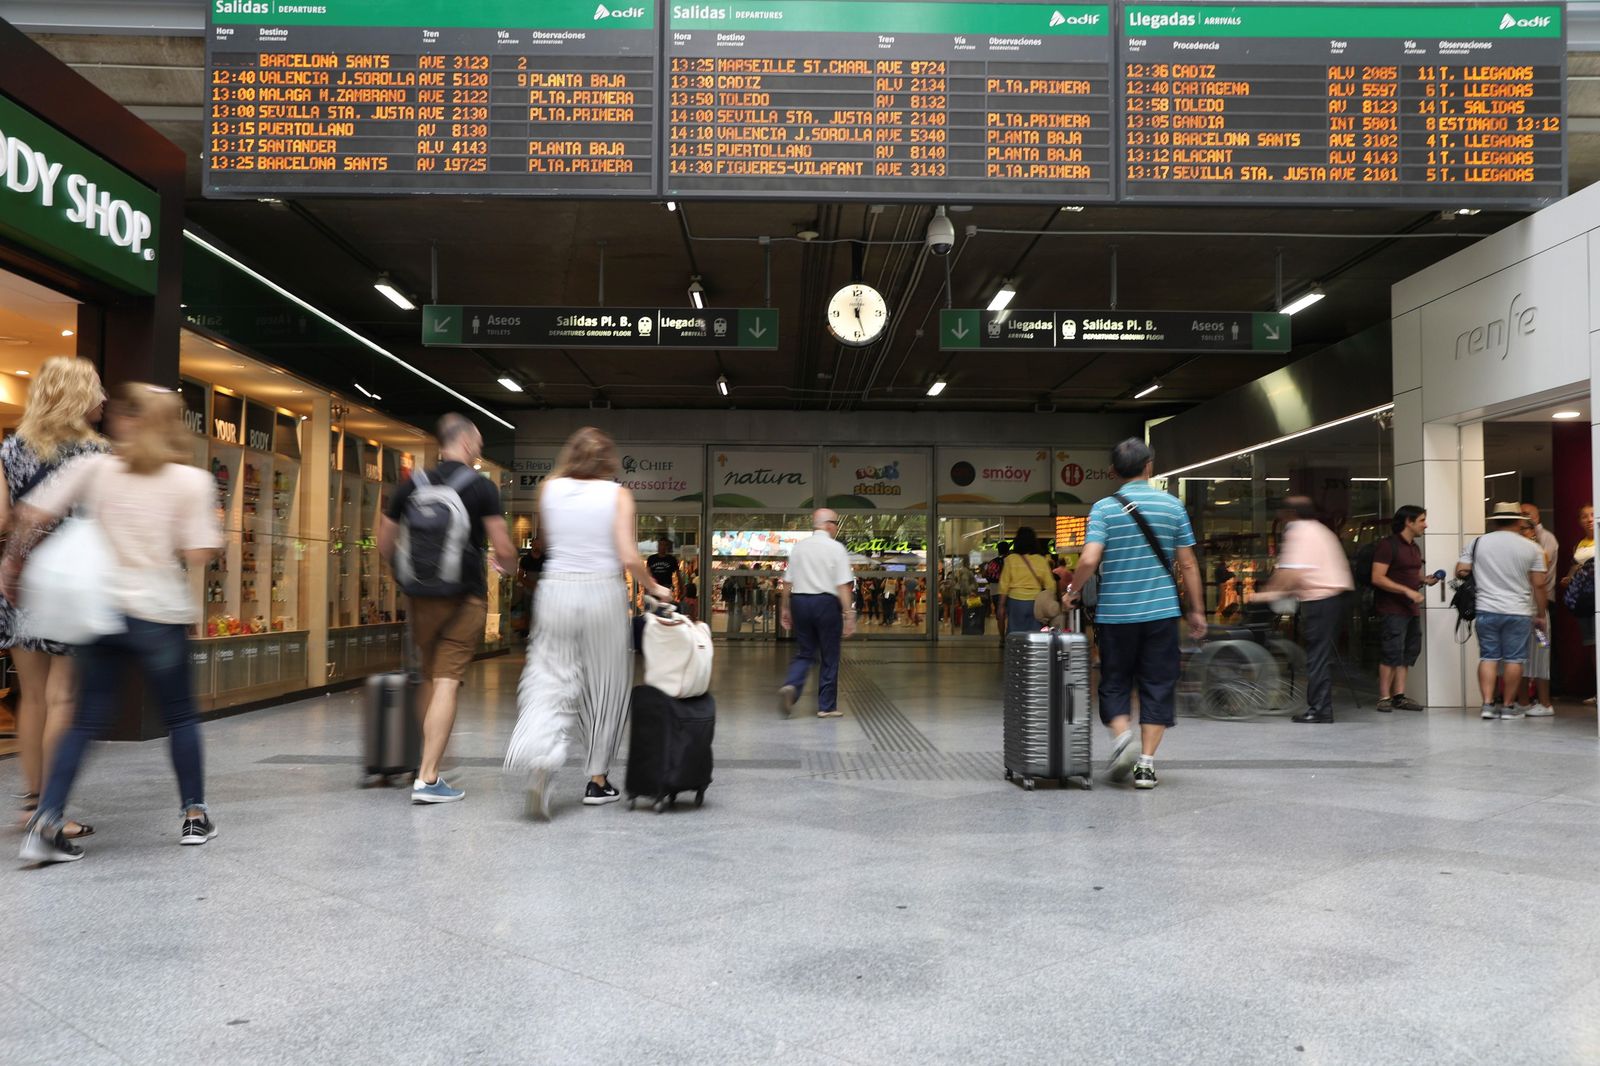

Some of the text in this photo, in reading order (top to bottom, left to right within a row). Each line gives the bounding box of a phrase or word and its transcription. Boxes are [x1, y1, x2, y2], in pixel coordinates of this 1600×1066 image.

[216, 0, 327, 14] Salidas DEPARTURES
[611, 6, 645, 18] adif
[673, 5, 783, 19] Salidas DEPARTURES
[1066, 14, 1101, 25] adif
[1129, 12, 1242, 29] Llegadas ARRIVALS
[1516, 15, 1552, 28] adif
[216, 27, 586, 40] Hora Destino Tren Observaciones
[717, 33, 1042, 46] Destino Observaciones
[1173, 41, 1220, 51] Procedencia
[259, 53, 489, 70] BARCELONA SANTS AVE 3123
[672, 58, 945, 75] 13:25 MARSEILLE ST.CHARL AVE 9724
[212, 70, 626, 88] 12:40 VALENCIA J.SOROLLA AVE 5120 PLANTA BAJA
[1127, 63, 1534, 81] 12:36 CADIZ LLEGADAS
[672, 75, 1091, 95] 13:30 CADIZ ALV 2134 PLTA.PRIMERA
[1127, 80, 1534, 98] 12:40 CARTAGENA LLEGADAS
[212, 87, 635, 105] 13:00 MALAGA M.ZAMBRANO AVE 2122 PLTA.PRIMERA
[671, 92, 946, 109] 13:50 TOLEDO 8132
[212, 104, 634, 122] 13:00 SEVILLA JUSTA AVE 2130 PLTA.PRIMERA
[1127, 97, 1526, 115] 12:58 TOLEDO SALIDAS
[671, 109, 1091, 129] 14:00 SEVILLA JUSTA 2140 PLTA.PRIMERA
[1127, 114, 1560, 132] 13:05 GANDIA ESTIMADO 13:12
[211, 121, 488, 138] 13:15 PUERTOLLANO 8130
[671, 126, 1083, 145] 14:10 VALENCIA J.SOROLLA 5340 PLANTA BAJA
[211, 138, 625, 156] 13:17 SANTANDER ALV 4143 PLANTA BAJA
[1127, 131, 1535, 149] 13:10 BARCELONA SANTS LLEGADAS
[671, 143, 1083, 162] 14:15 PUERTOLLANO 8140 PLANTA BAJA
[1127, 148, 1534, 166] 13:12 ALACANT LLEGADAS
[211, 155, 634, 173] 13:25 BARCELONA SANTS 19725 PLTA.PRIMERA
[671, 160, 1091, 179] 14:30 FIGUERES-VILAFANT 3143 PLTA.PRIMERA
[1127, 165, 1535, 183] 13:17 SEVILLA JUSTA LLEGADAS
[487, 314, 521, 326] Aseos
[556, 315, 598, 327] Salidas
[619, 316, 632, 327] B.
[661, 316, 706, 330] Llegadas
[1008, 319, 1053, 331] Llegadas
[1082, 319, 1124, 330] Salidas
[1145, 320, 1158, 331] B.
[1191, 320, 1225, 331] Aseos
[1454, 292, 1538, 360] renfe
[214, 418, 237, 444] YOUR
[250, 429, 270, 451] BODY
[613, 475, 688, 492] ccessorize
[724, 468, 807, 486] natura
